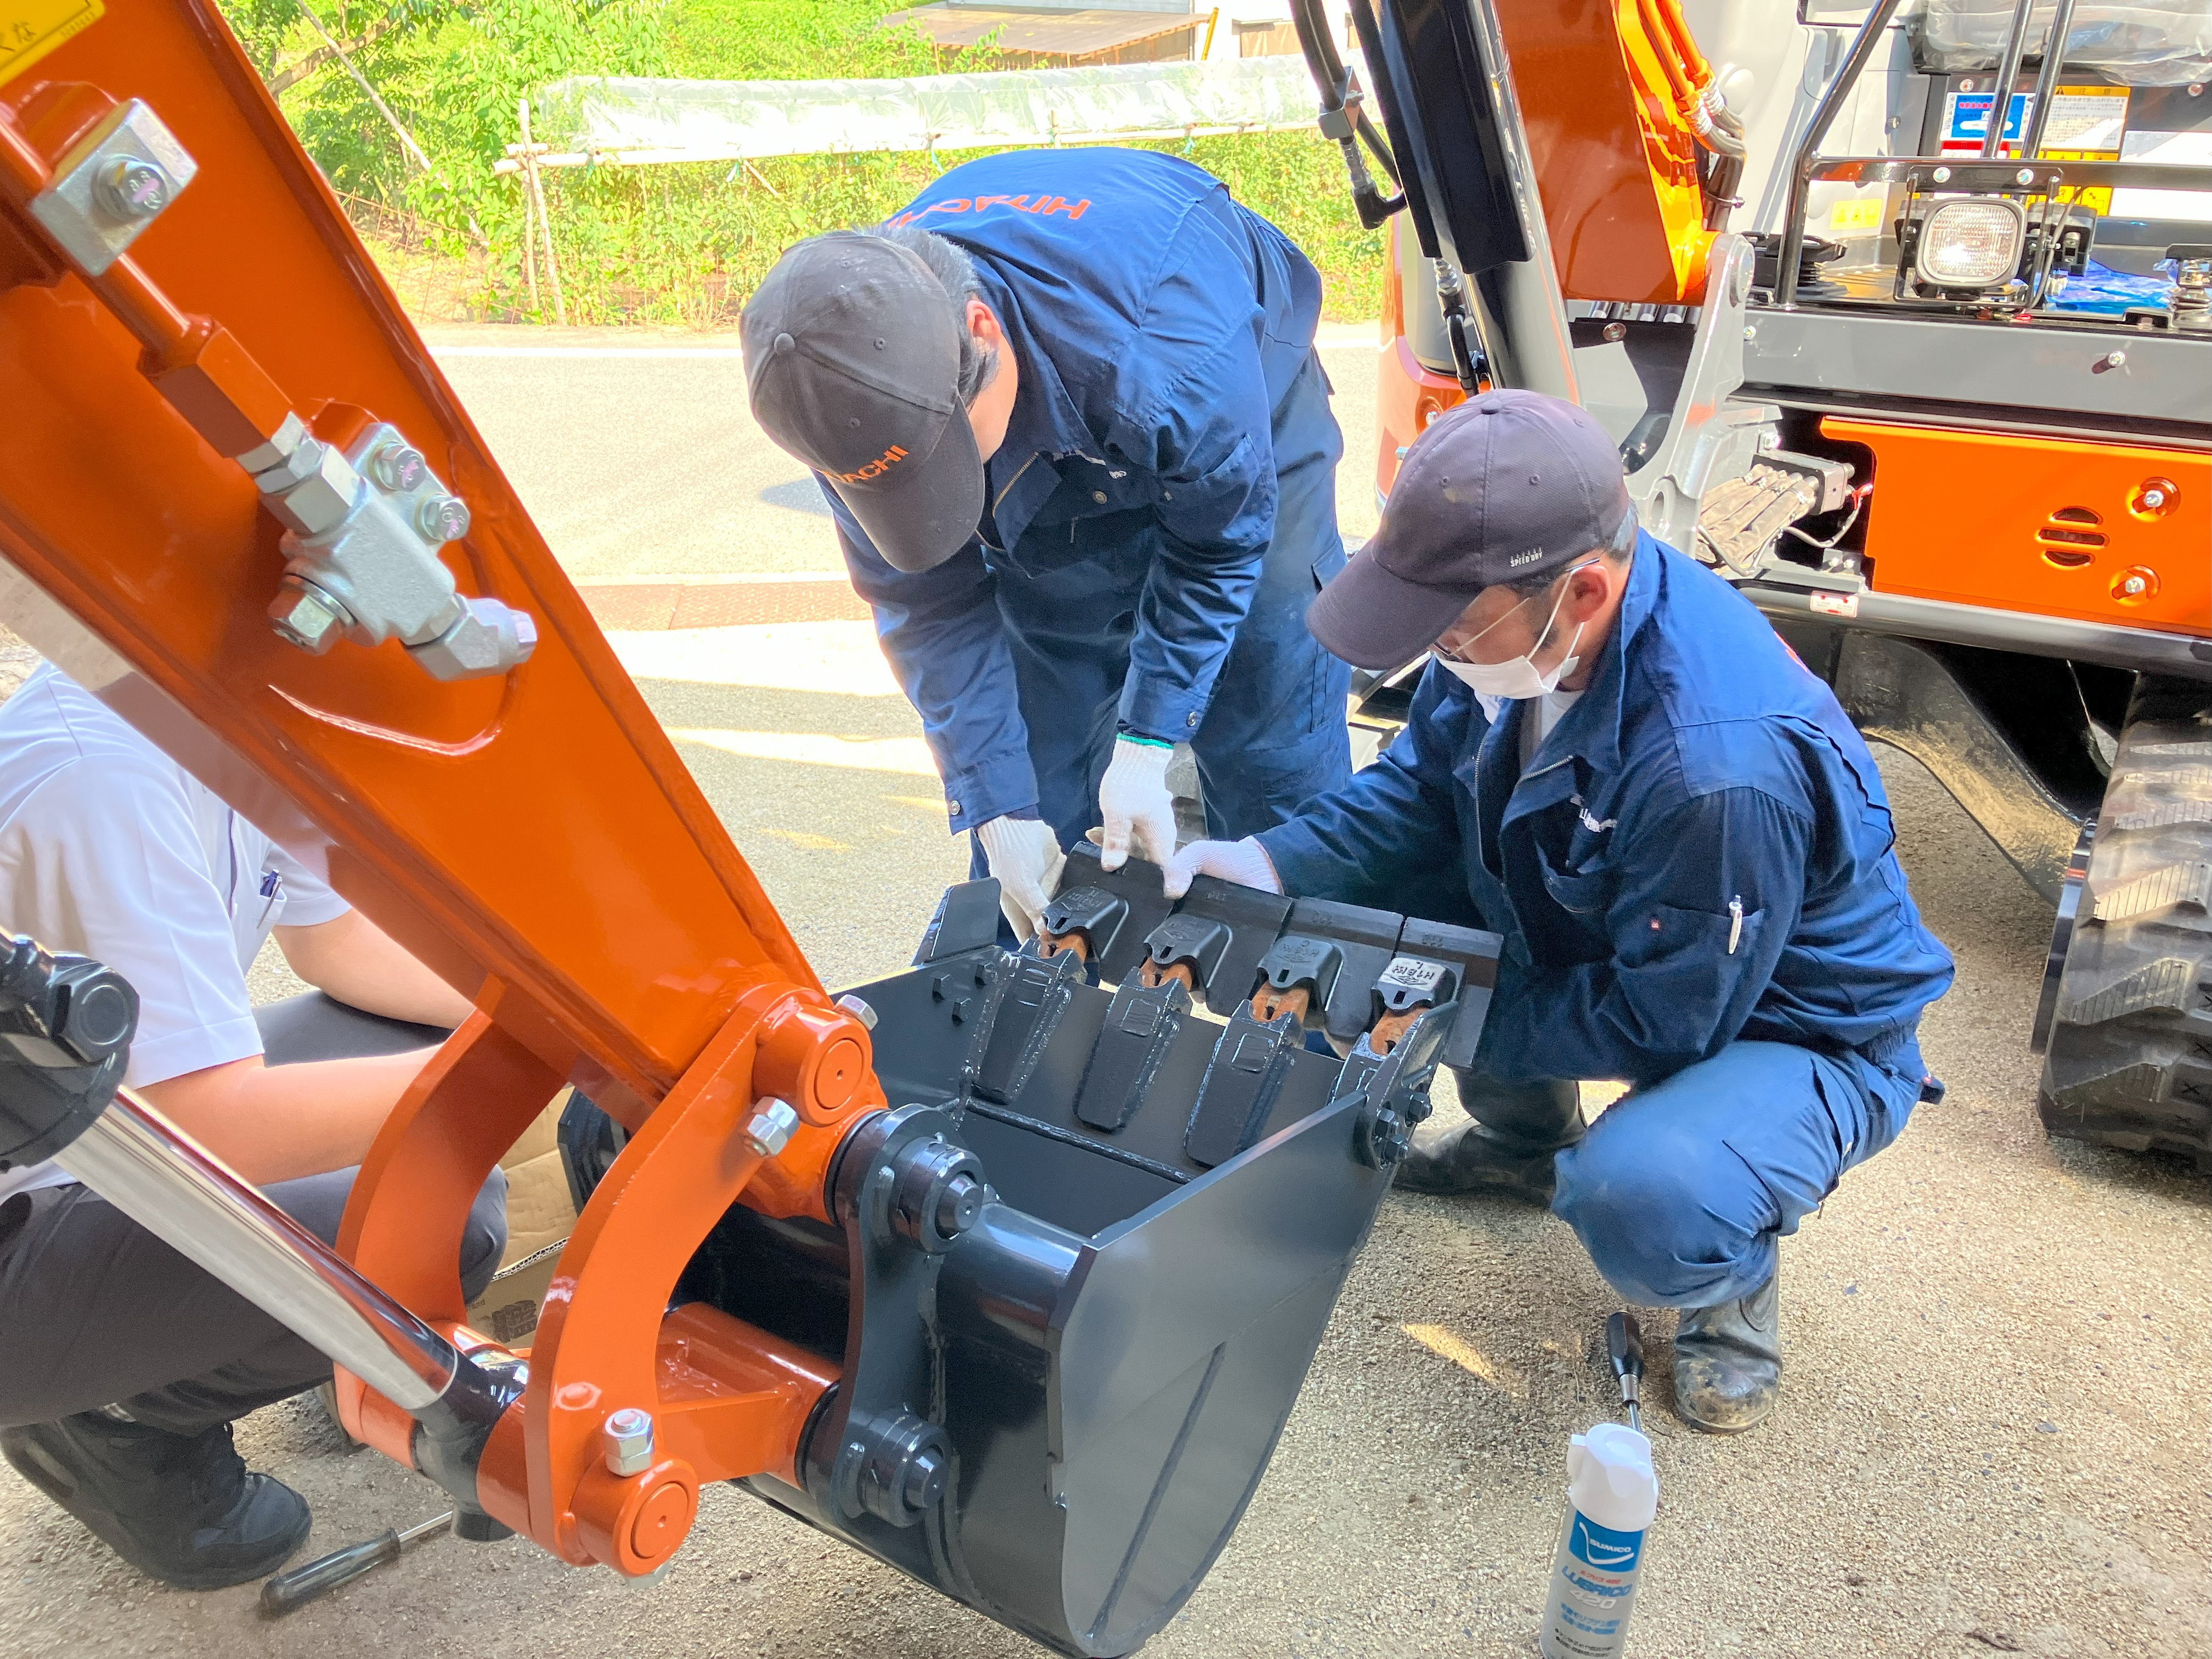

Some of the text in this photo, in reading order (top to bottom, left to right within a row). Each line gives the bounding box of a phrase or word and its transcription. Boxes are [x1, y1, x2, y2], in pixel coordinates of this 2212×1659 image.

[1589, 1538, 1631, 1553] SUMICO
[1562, 1565, 1633, 1598] LUBRICO
[1570, 1590, 1617, 1610] 420
